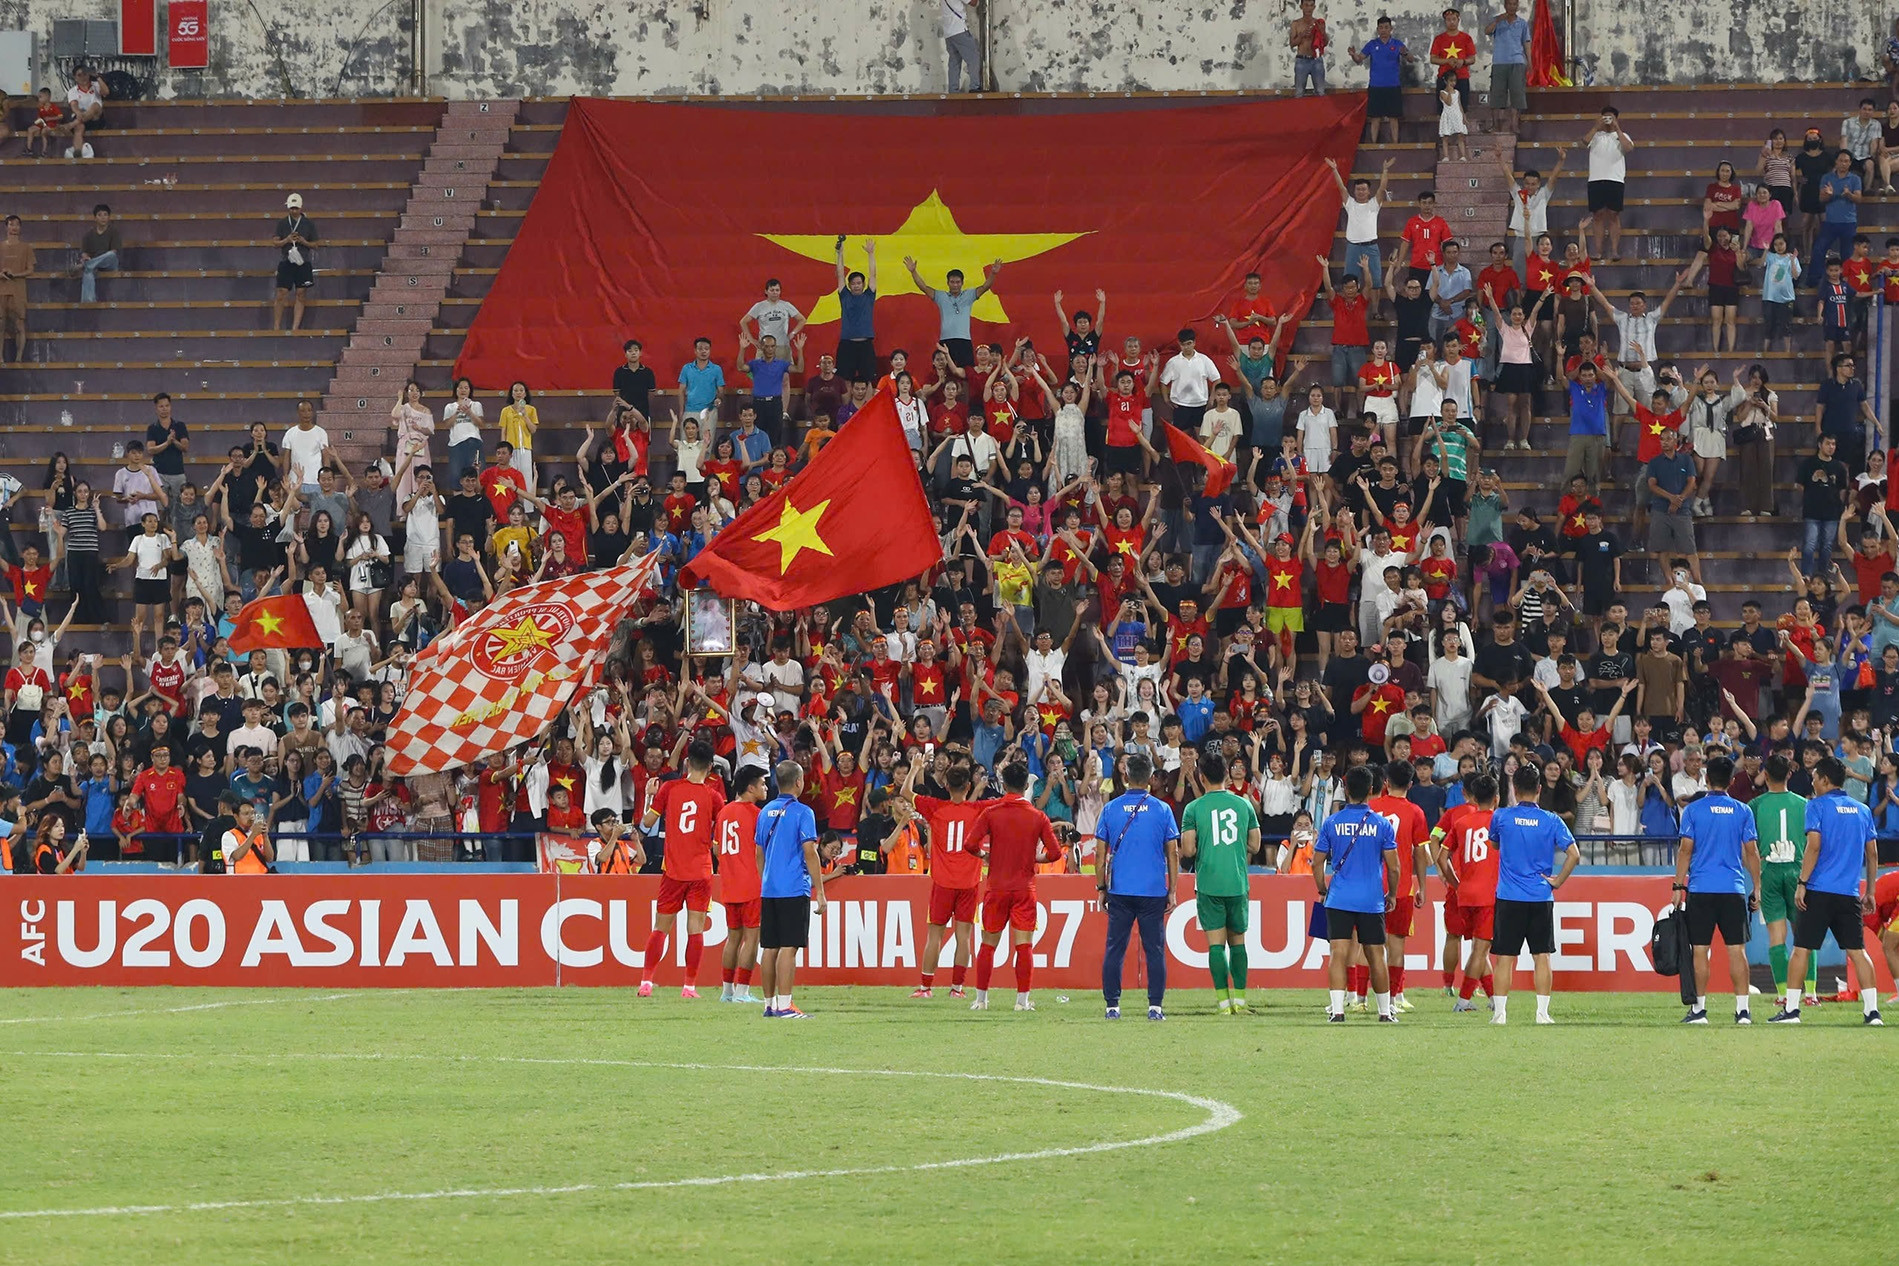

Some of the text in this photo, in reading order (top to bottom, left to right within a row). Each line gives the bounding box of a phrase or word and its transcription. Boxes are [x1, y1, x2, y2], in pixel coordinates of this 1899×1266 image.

[178, 21, 199, 36] 5G
[1423, 228, 1430, 239] 11
[679, 800, 698, 834] 2
[1211, 808, 1238, 846] 13
[1514, 817, 1539, 827] VIETNAM
[1710, 806, 1734, 814] VIETNAM
[1780, 808, 1788, 843] 1
[1836, 806, 1859, 814] VIETNAM
[721, 819, 740, 855] 15
[947, 820, 964, 852] 11
[1464, 826, 1489, 863] 18
[20, 899, 46, 967] AFC
[57, 898, 227, 968] U20
[240, 899, 519, 967] ASIAN
